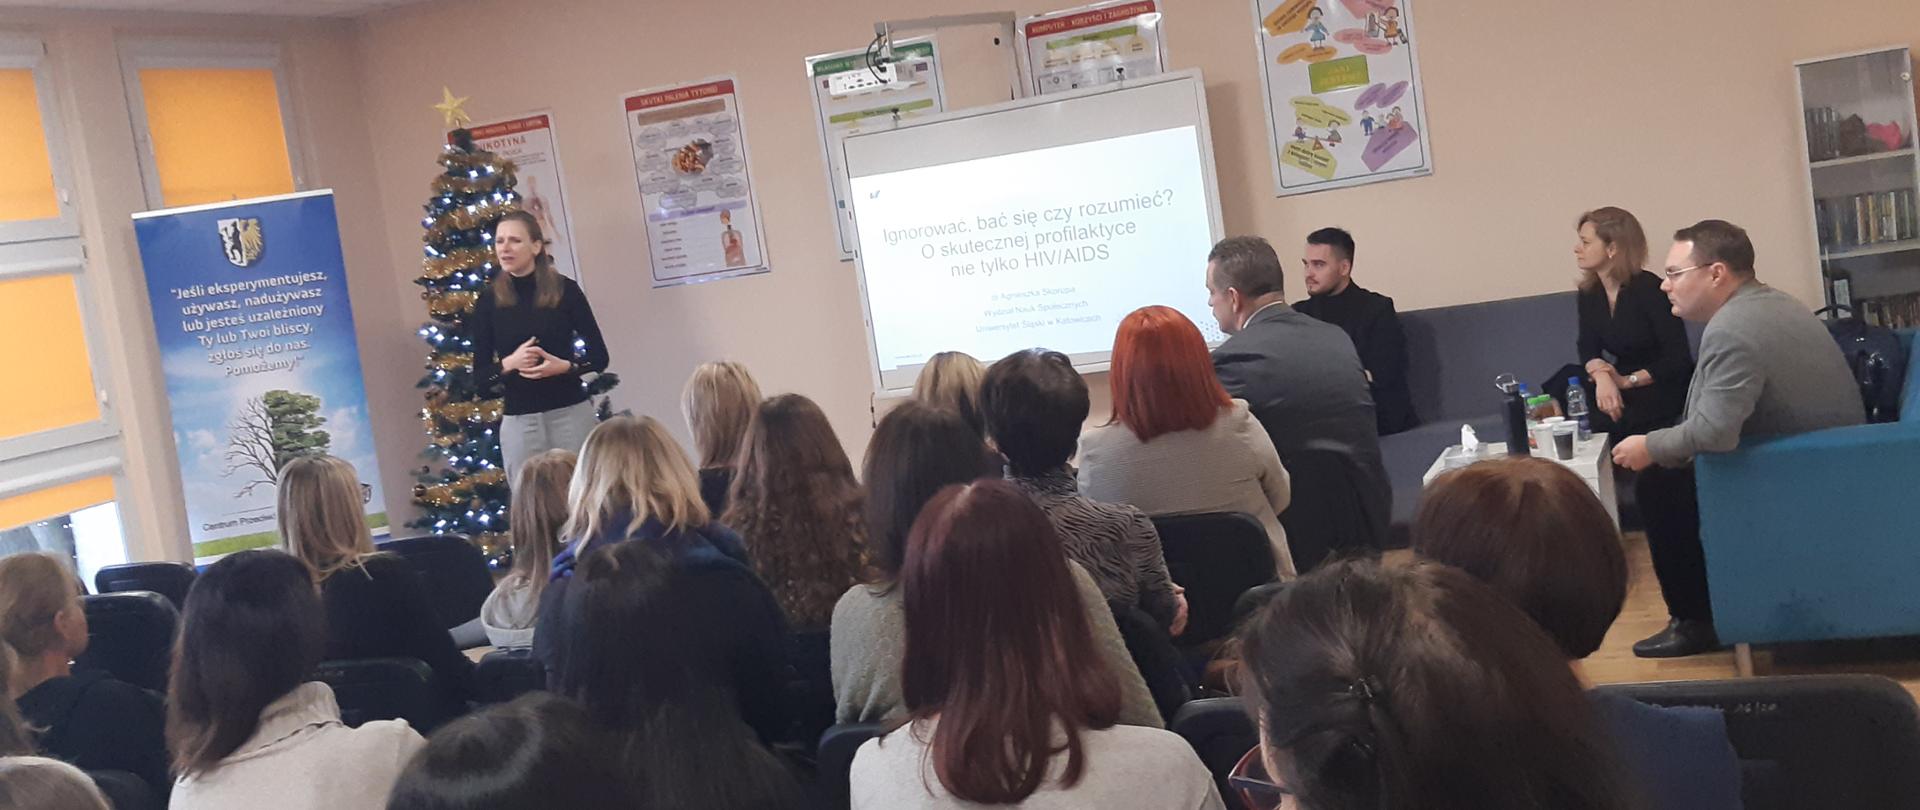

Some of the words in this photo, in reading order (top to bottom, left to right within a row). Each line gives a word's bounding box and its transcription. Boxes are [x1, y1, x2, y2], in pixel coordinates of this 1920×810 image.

[976, 211, 1008, 230] bać
[1013, 210, 1038, 227] się
[1043, 206, 1072, 223] czy
[1079, 188, 1174, 217] rozumieć?
[921, 243, 935, 259] O
[940, 231, 1029, 257] skutecznej
[1035, 221, 1137, 248] profilaktyce
[951, 262, 975, 277] nie
[981, 256, 1019, 277] tylko
[1025, 243, 1110, 268] HIV/AIDS
[208, 272, 328, 295] eksperymentujesz,
[182, 299, 241, 316] używasz,
[244, 287, 322, 306] nadużywasz
[182, 320, 204, 332] lub
[206, 313, 246, 332] jesteś
[248, 303, 324, 323] uzależniony
[198, 335, 215, 348] Ty
[217, 331, 237, 344] lub
[241, 328, 271, 341] Twoi
[273, 321, 313, 336] bliscy,
[245, 345, 264, 359] się
[267, 341, 282, 354] do
